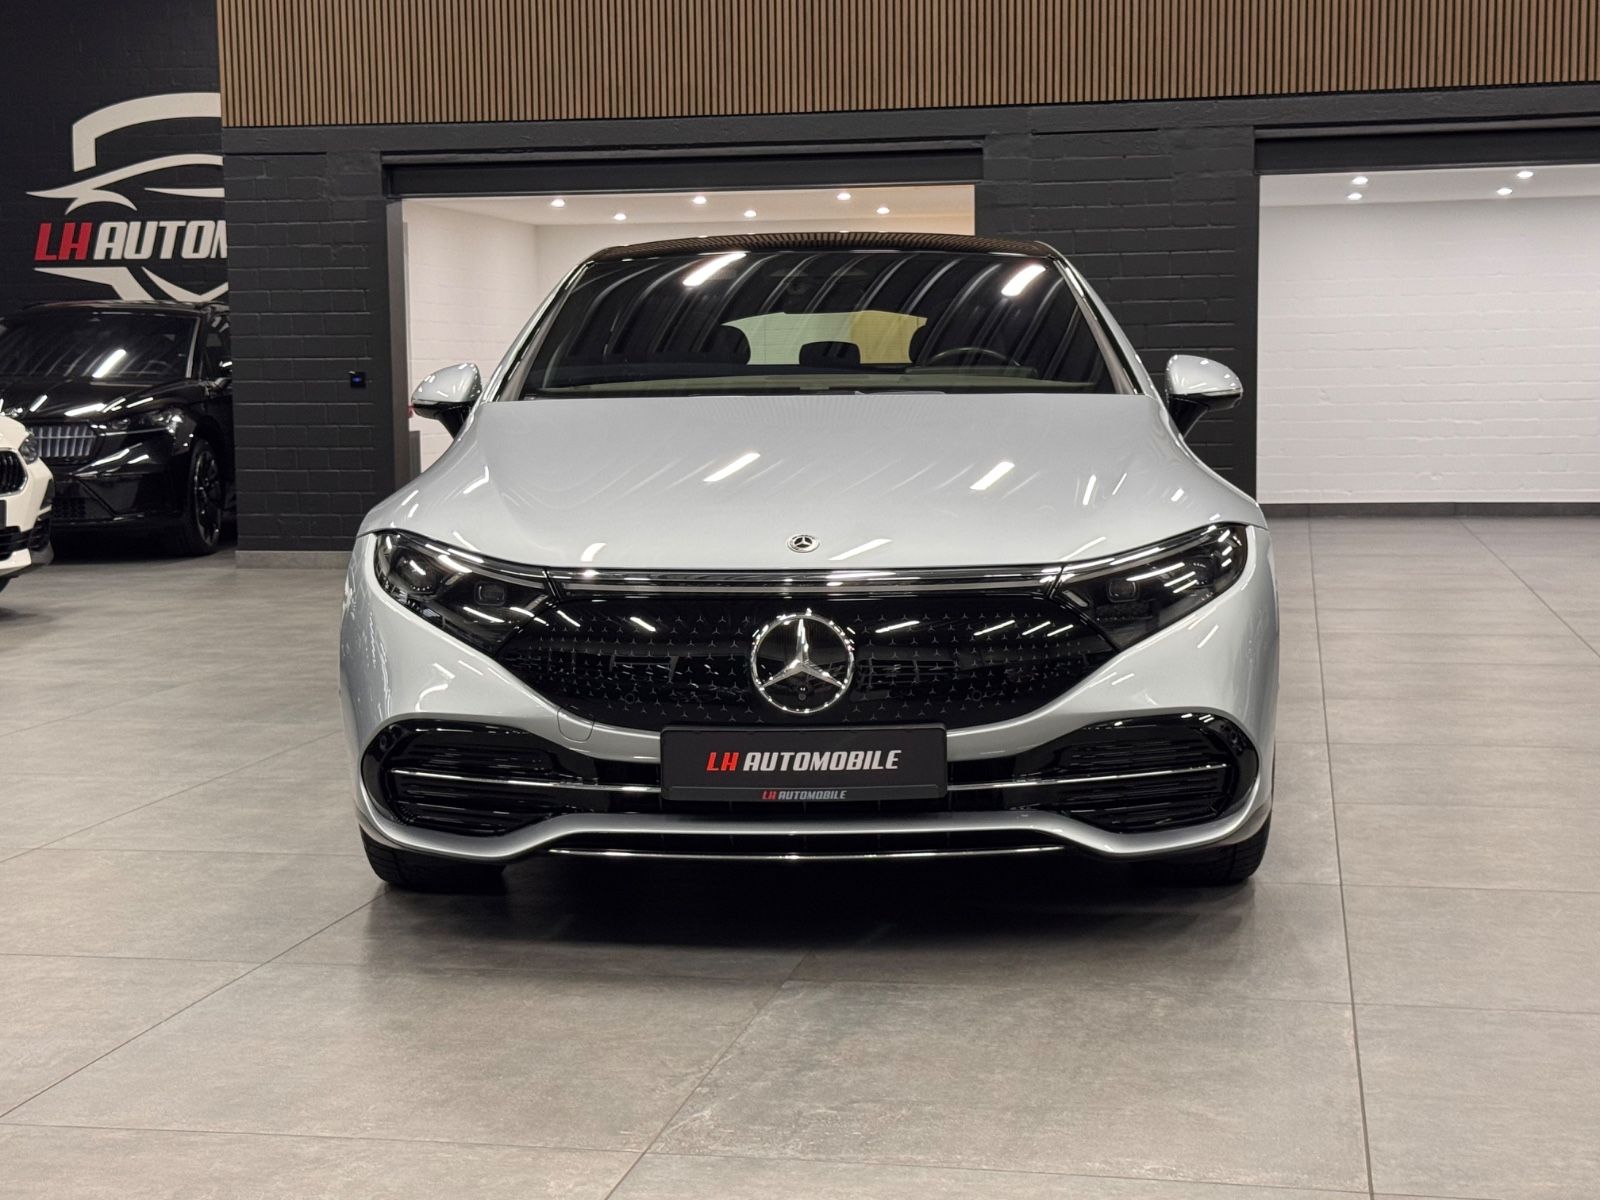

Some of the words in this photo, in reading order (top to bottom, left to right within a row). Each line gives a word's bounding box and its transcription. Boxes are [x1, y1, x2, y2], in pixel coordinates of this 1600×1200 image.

[34, 221, 93, 261] LH
[706, 751, 740, 772] LH
[743, 749, 902, 772] AUTOMOBILE
[761, 790, 777, 800] LH
[778, 790, 848, 800] AUTOMOBILE
